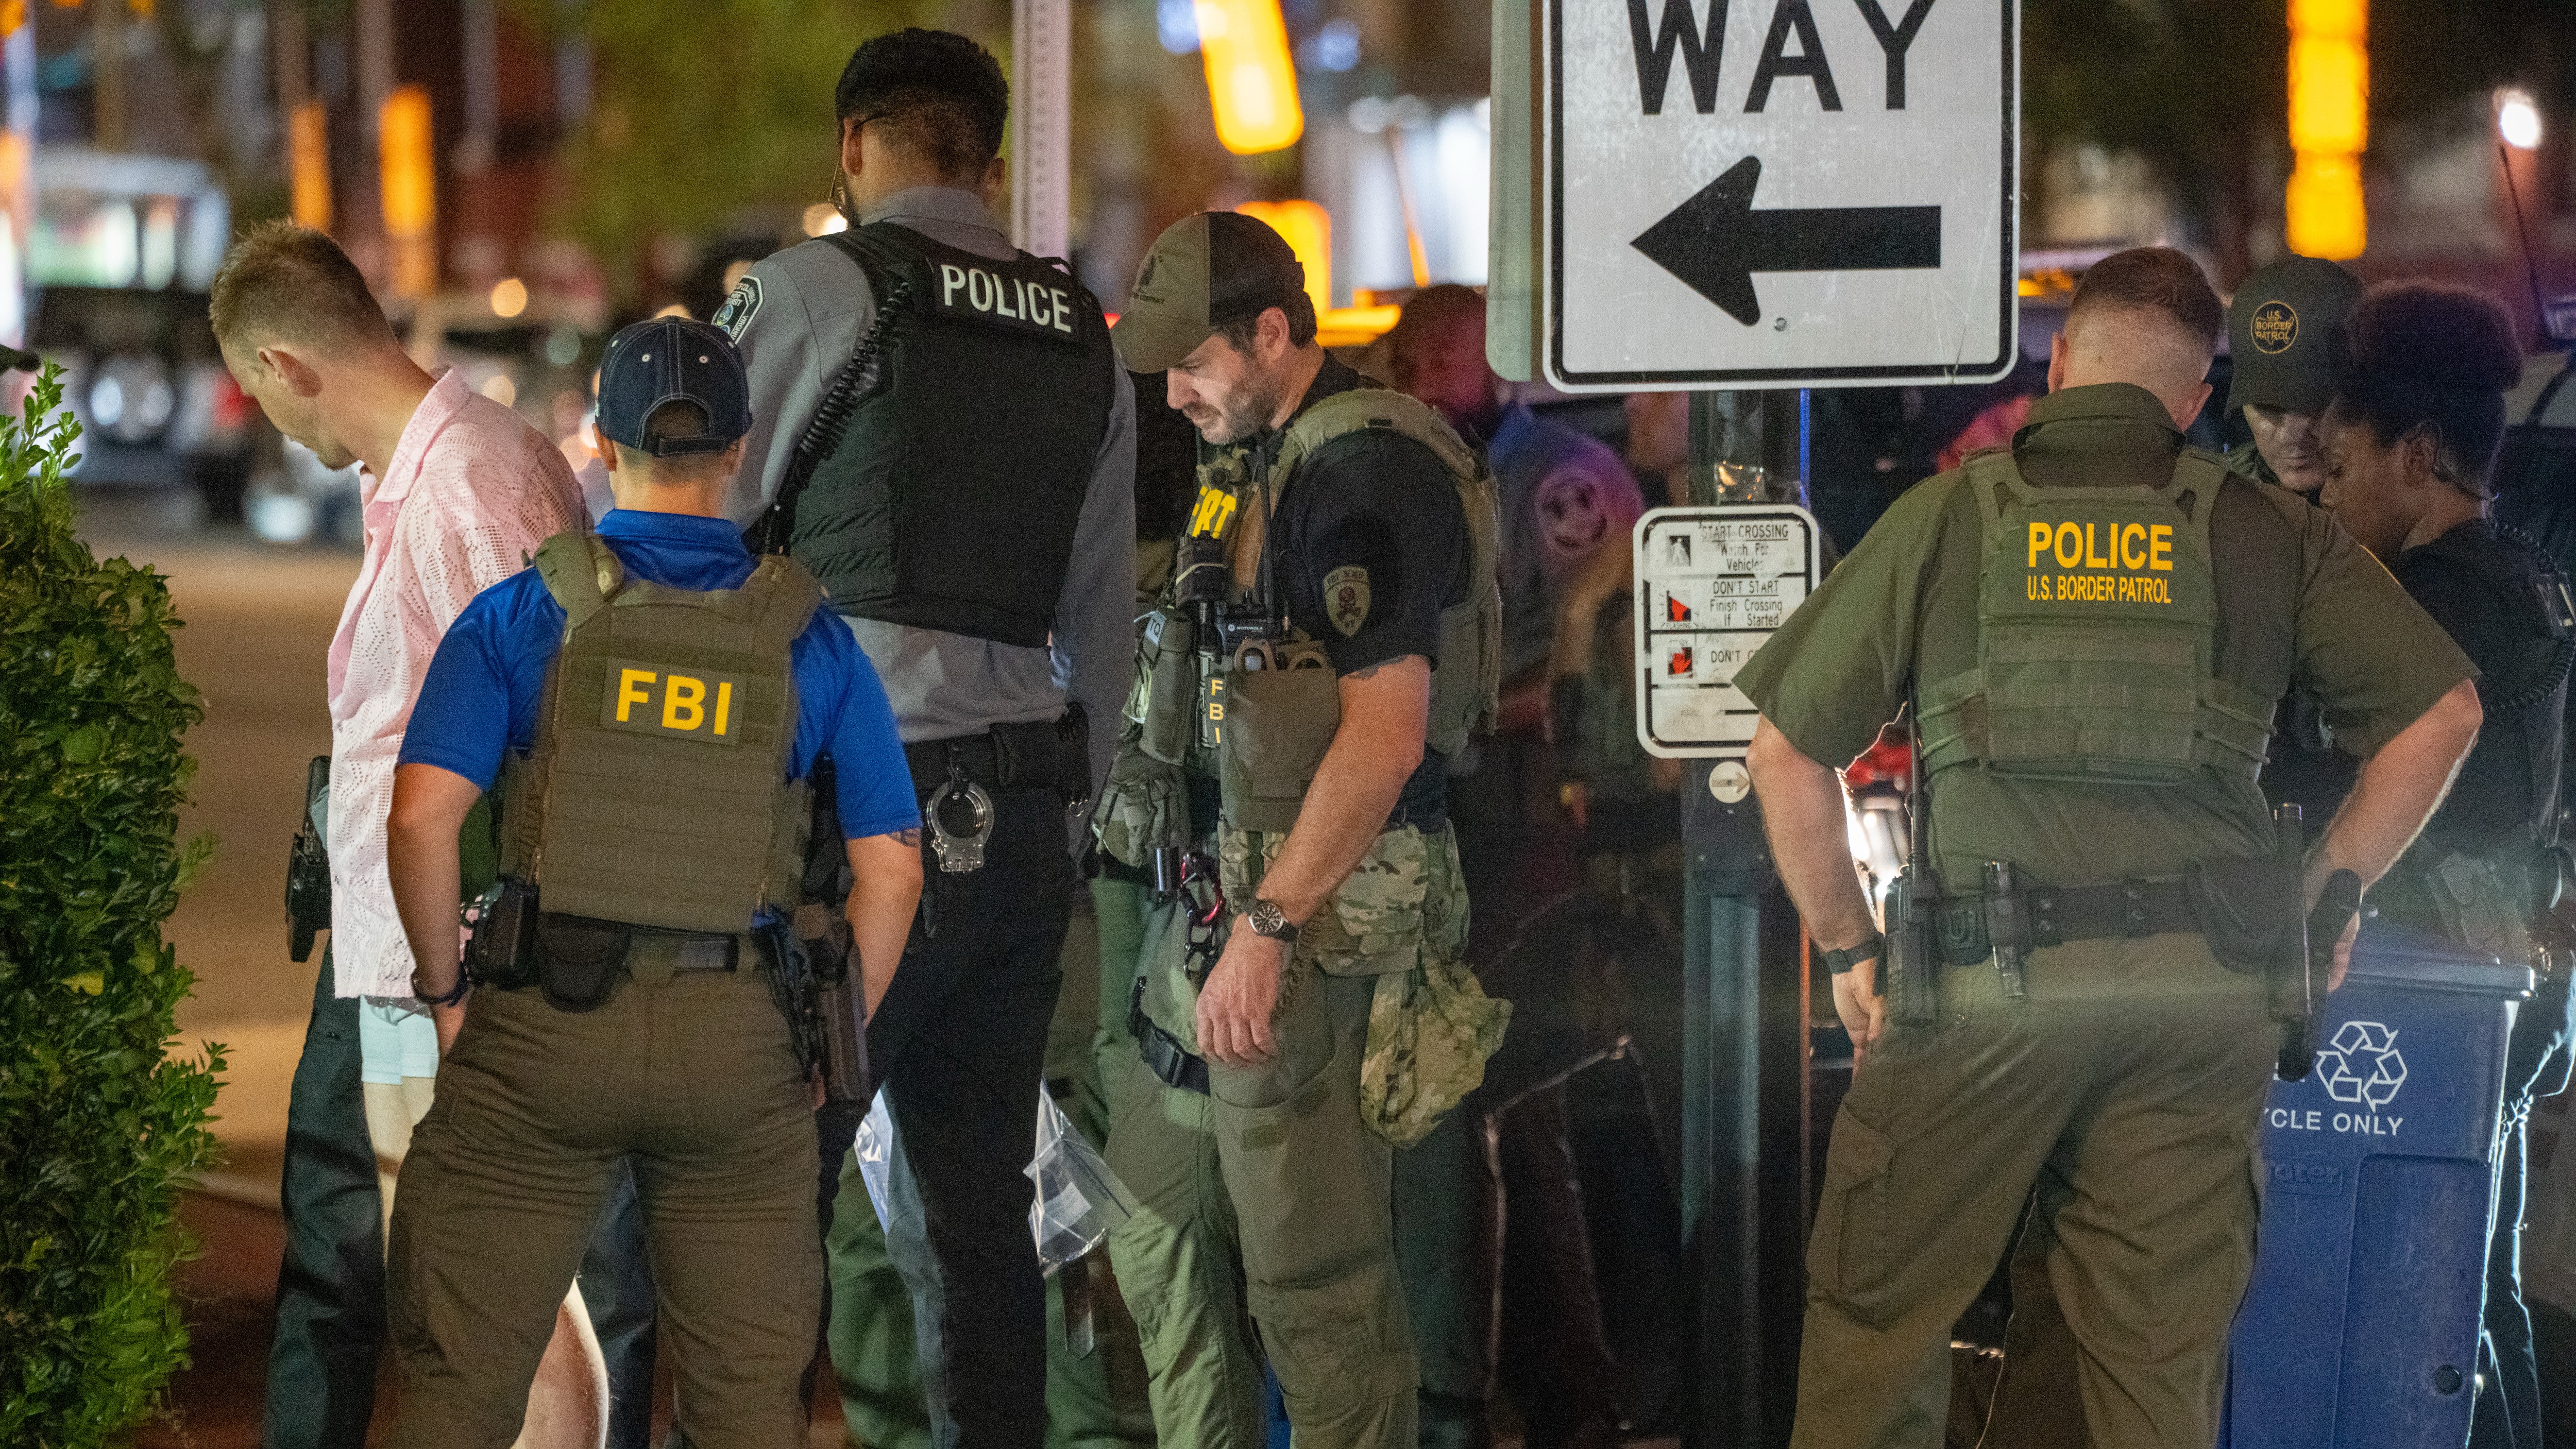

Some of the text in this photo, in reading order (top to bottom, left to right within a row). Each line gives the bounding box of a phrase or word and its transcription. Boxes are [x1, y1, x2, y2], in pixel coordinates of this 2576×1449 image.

[1627, 0, 1936, 115] WAY
[940, 264, 1072, 333] POLICE
[2256, 321, 2292, 330] BORDER
[2255, 331, 2290, 340] PATROL
[1702, 524, 1788, 539] START CROSSING
[1720, 542, 1769, 556] Wtch For
[2028, 521, 2173, 571] POLICE
[1713, 579, 1779, 594] DON'T START
[2027, 575, 2172, 604] U.S. BORDER PATROL
[1710, 598, 1783, 615] Finish Crossing
[1149, 618, 1161, 637] TQ
[1724, 613, 1779, 627] If Started
[1710, 650, 1740, 663] DON'T
[616, 668, 732, 736] FBI
[1209, 679, 1224, 744] FBI
[2264, 1108, 2403, 1136] CLE ONLY
